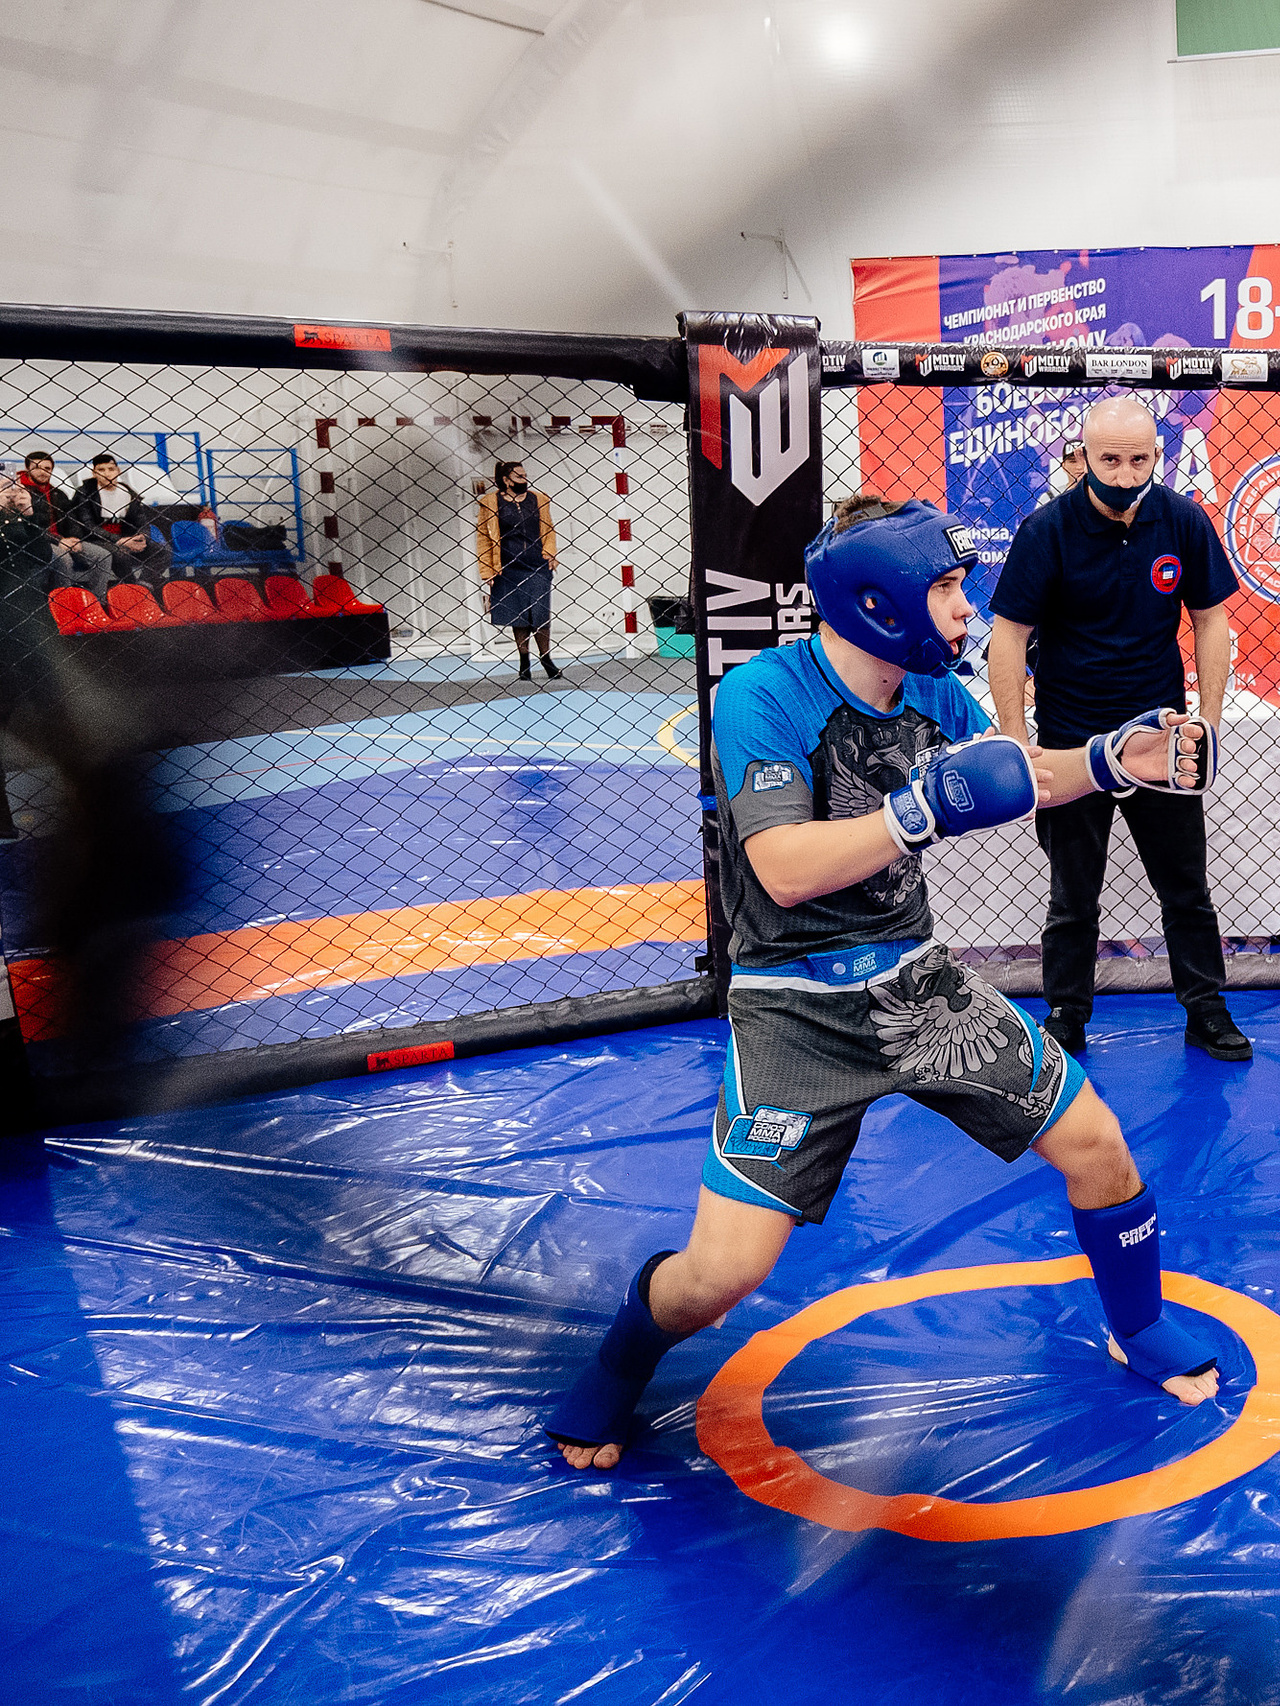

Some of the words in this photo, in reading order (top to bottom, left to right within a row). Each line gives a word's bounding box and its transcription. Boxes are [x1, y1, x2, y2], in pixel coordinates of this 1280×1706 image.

[943, 300, 1016, 330] ЧЕМПИОНАТ
[1017, 298, 1027, 313] И
[1028, 278, 1106, 310] ПЕРВЕНСТВО
[963, 312, 1073, 346] КРАСНОДАРСКОГО
[1074, 303, 1106, 324] КРАЯ
[324, 332, 384, 347] SPARTA
[822, 355, 847, 366] OTIV
[932, 354, 966, 366] MOTIV
[1038, 355, 1071, 367] MOTIV
[1111, 359, 1147, 367] LONDON
[1183, 357, 1214, 369] MOTIV
[976, 382, 1098, 418] БОЕВО
[853, 958, 878, 972] ММА
[854, 951, 876, 966] СОЮЗ
[394, 1048, 447, 1065] SPARTA
[750, 1128, 781, 1138] ММА
[753, 1121, 786, 1133] СОЮЗ
[1119, 1212, 1157, 1241] GREEN
[1121, 1222, 1155, 1248] HILL
